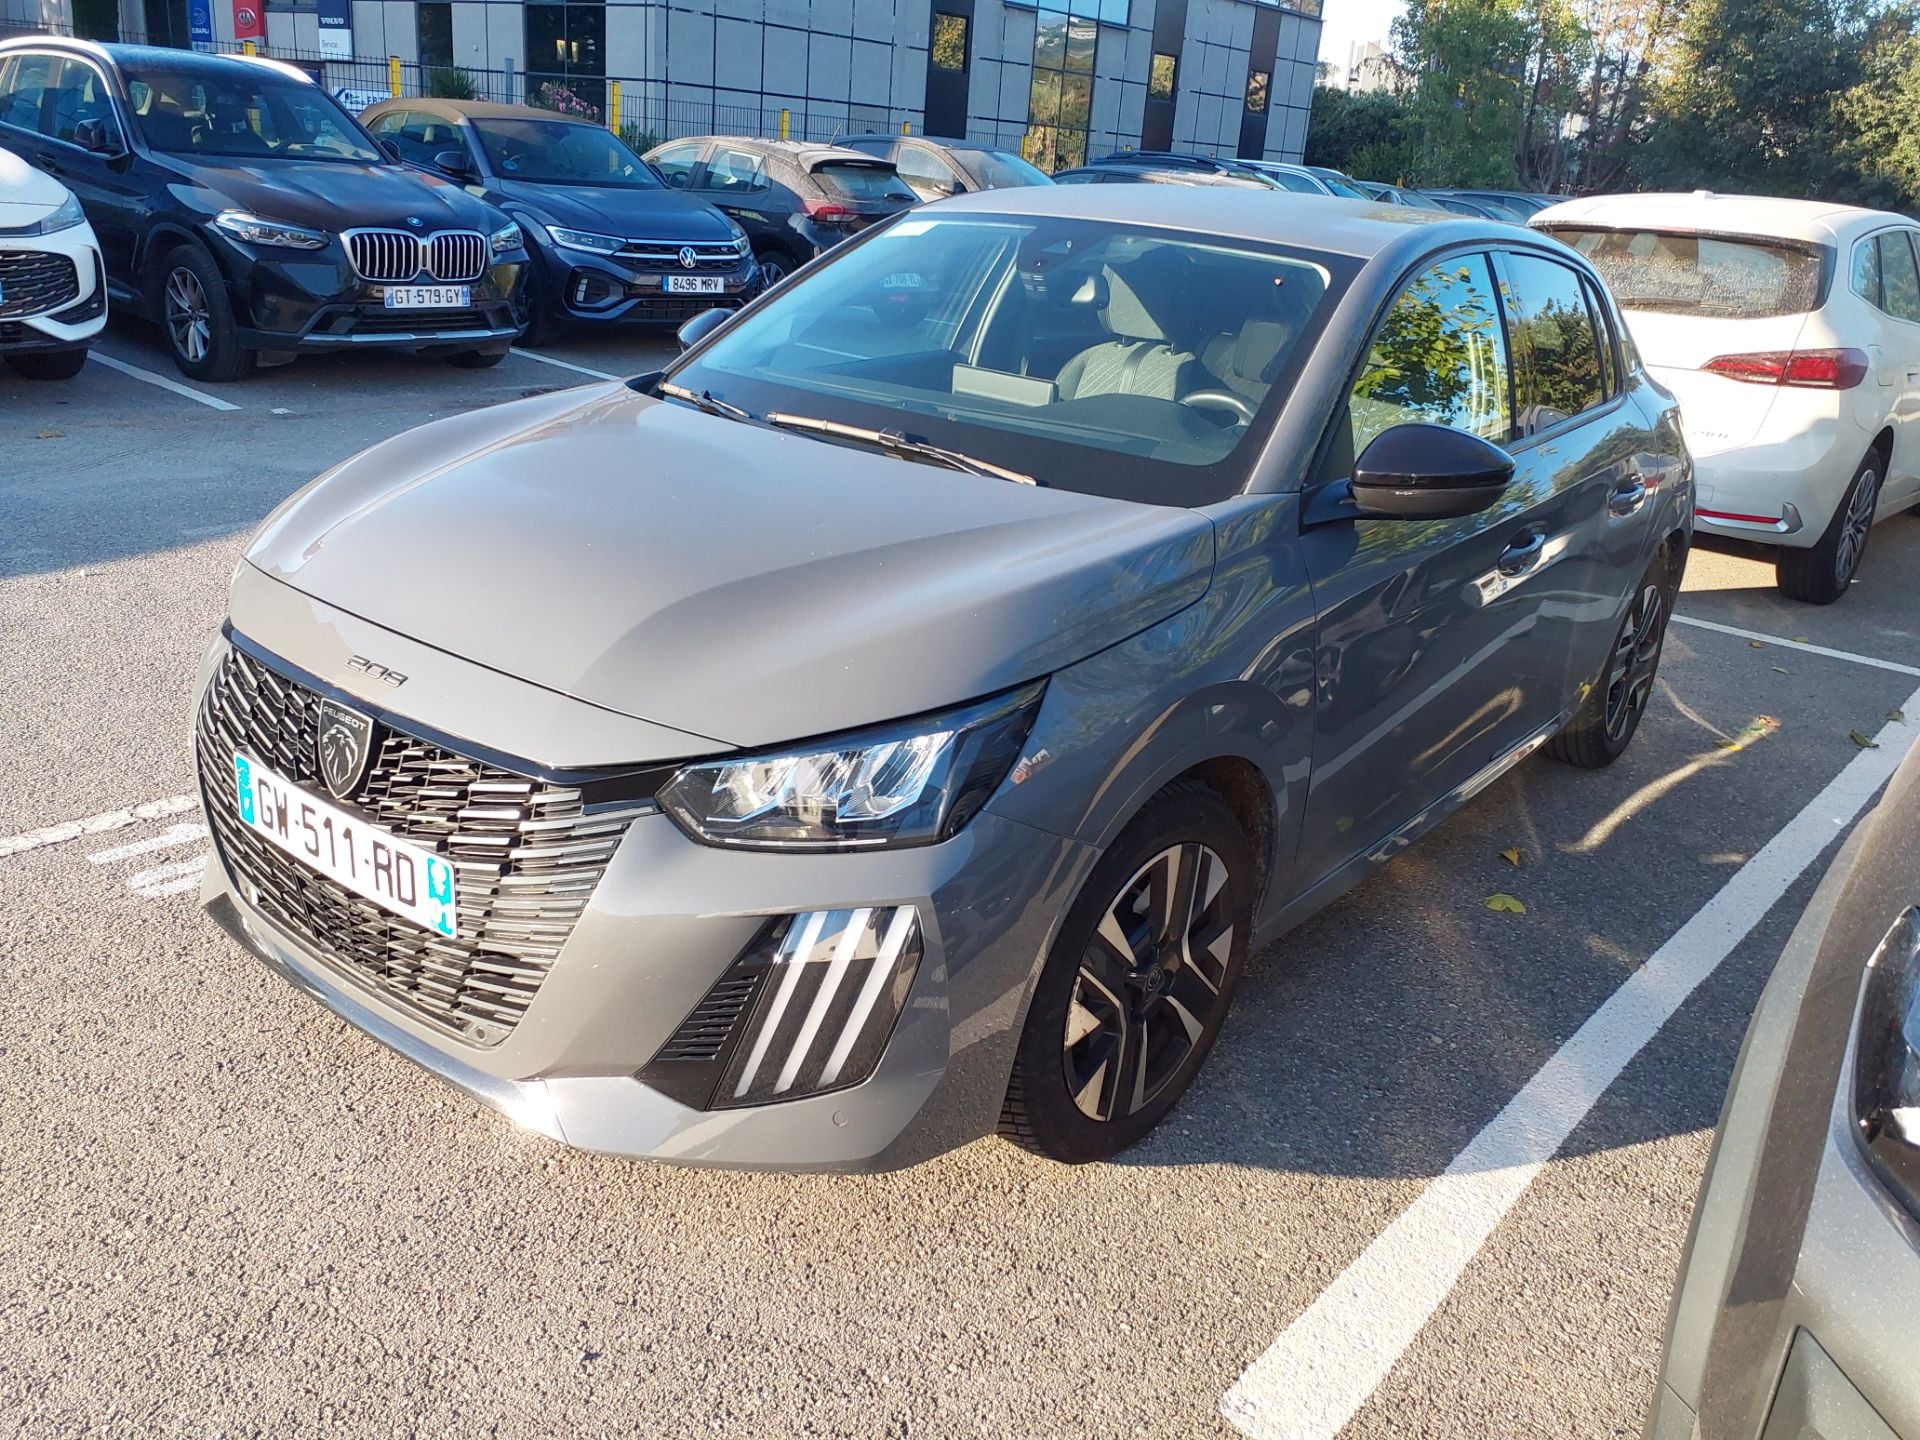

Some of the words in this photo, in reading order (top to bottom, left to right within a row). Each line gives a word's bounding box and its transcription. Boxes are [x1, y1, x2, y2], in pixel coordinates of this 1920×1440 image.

[237, 12, 252, 23] KIA
[320, 17, 345, 25] VOLVO
[672, 278, 697, 291] 8496
[701, 278, 719, 291] MRV
[394, 288, 462, 304] GT-579-GY
[344, 654, 409, 688] 208
[323, 705, 367, 731] PEUGEOT
[257, 776, 417, 908] GW-511-RD
